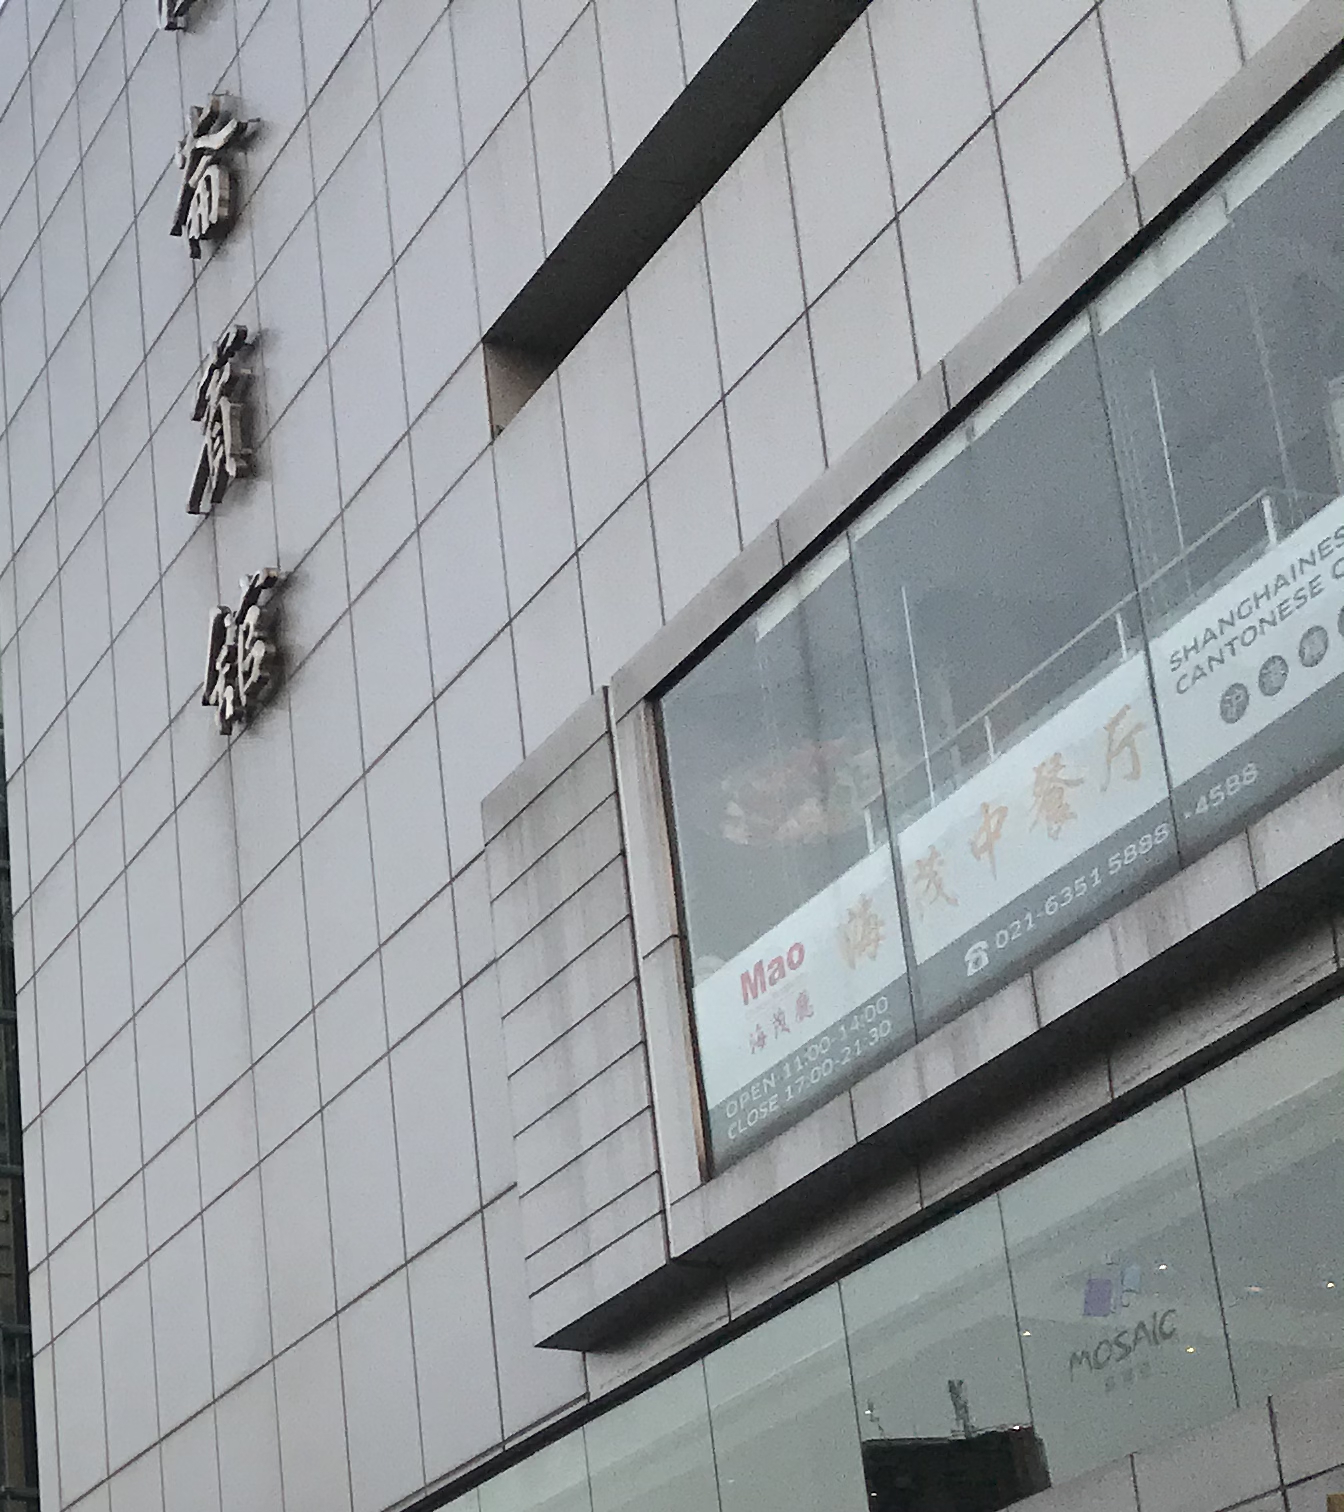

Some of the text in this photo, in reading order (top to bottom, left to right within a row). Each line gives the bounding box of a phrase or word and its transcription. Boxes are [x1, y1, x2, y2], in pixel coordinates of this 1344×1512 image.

[1176, 574, 1325, 694] CANTONESE
[996, 868, 1103, 949] 021-6351
[740, 942, 806, 1005] Mao
[726, 1073, 776, 1118] OPEN
[727, 1094, 780, 1140] CLOSE
[1069, 1309, 1177, 1383] MOSAIC
